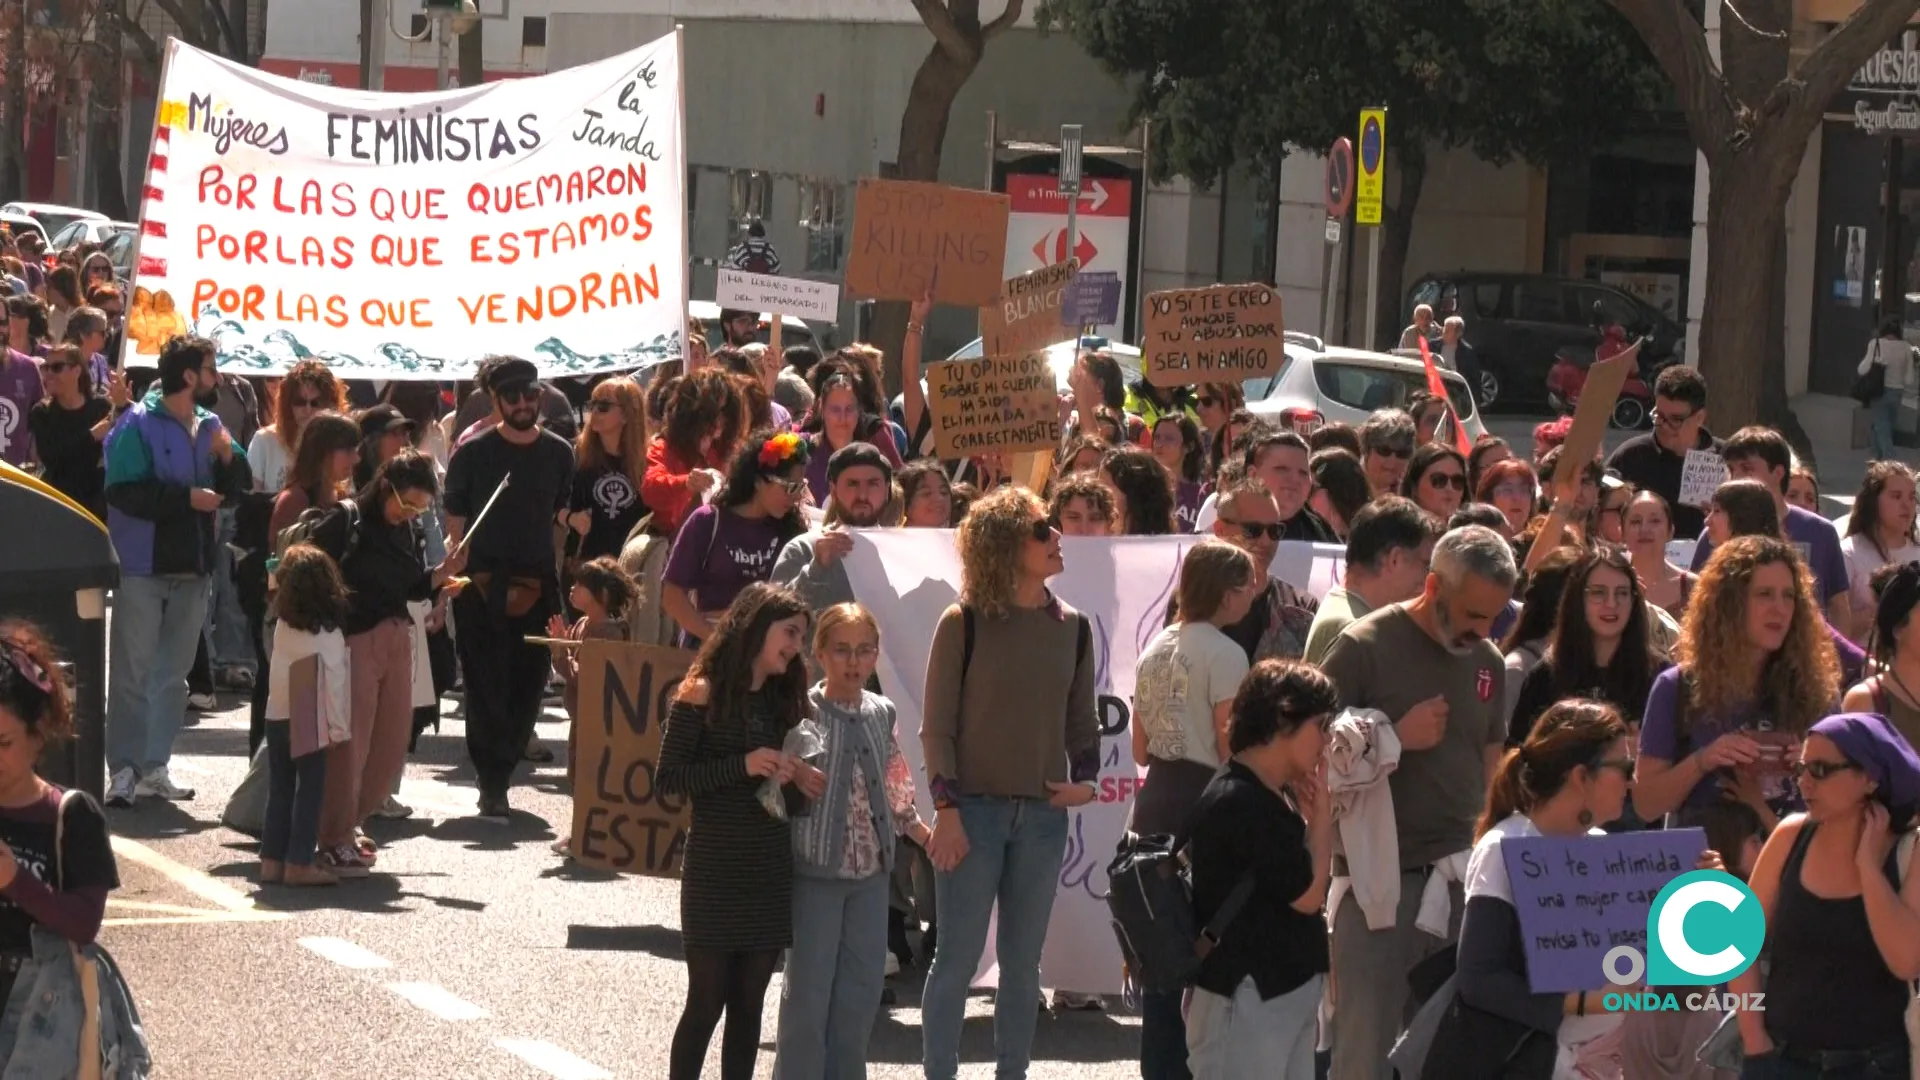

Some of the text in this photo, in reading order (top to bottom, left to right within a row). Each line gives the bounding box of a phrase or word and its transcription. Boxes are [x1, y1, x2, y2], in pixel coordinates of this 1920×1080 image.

[637, 60, 658, 88] de
[617, 80, 642, 114] la
[188, 92, 289, 155] Mujeres
[572, 108, 661, 161] Janda
[198, 162, 647, 222] POR LAS QUE QUEMARON
[872, 187, 944, 222] STOP
[197, 204, 653, 269] POR LAS QUE ESTAMOS
[864, 220, 989, 265] KILLING
[1008, 261, 1076, 297] FEMINISMO
[191, 278, 265, 321] POR
[276, 288, 349, 328] LAS
[360, 298, 433, 328] QUE
[1151, 296, 1171, 319] YO
[1200, 293, 1222, 313] TE
[1228, 290, 1272, 310] CREO
[1159, 323, 1278, 342] TU ABUSADOR
[1181, 312, 1236, 329] AUNQUE
[943, 364, 964, 381] TU
[1155, 352, 1190, 371] SEA
[940, 382, 979, 399] SOBRE
[985, 382, 998, 394] MI
[942, 408, 1024, 430] ELIMINADA
[960, 401, 974, 413] HA
[952, 421, 1060, 449] CORRECTAMENTE
[1098, 694, 1134, 735] D
[1521, 849, 1682, 879] Si te intimida
[1537, 886, 1664, 917] una mujer cap
[1535, 929, 1579, 950] revisa
[1582, 927, 1601, 949] tu
